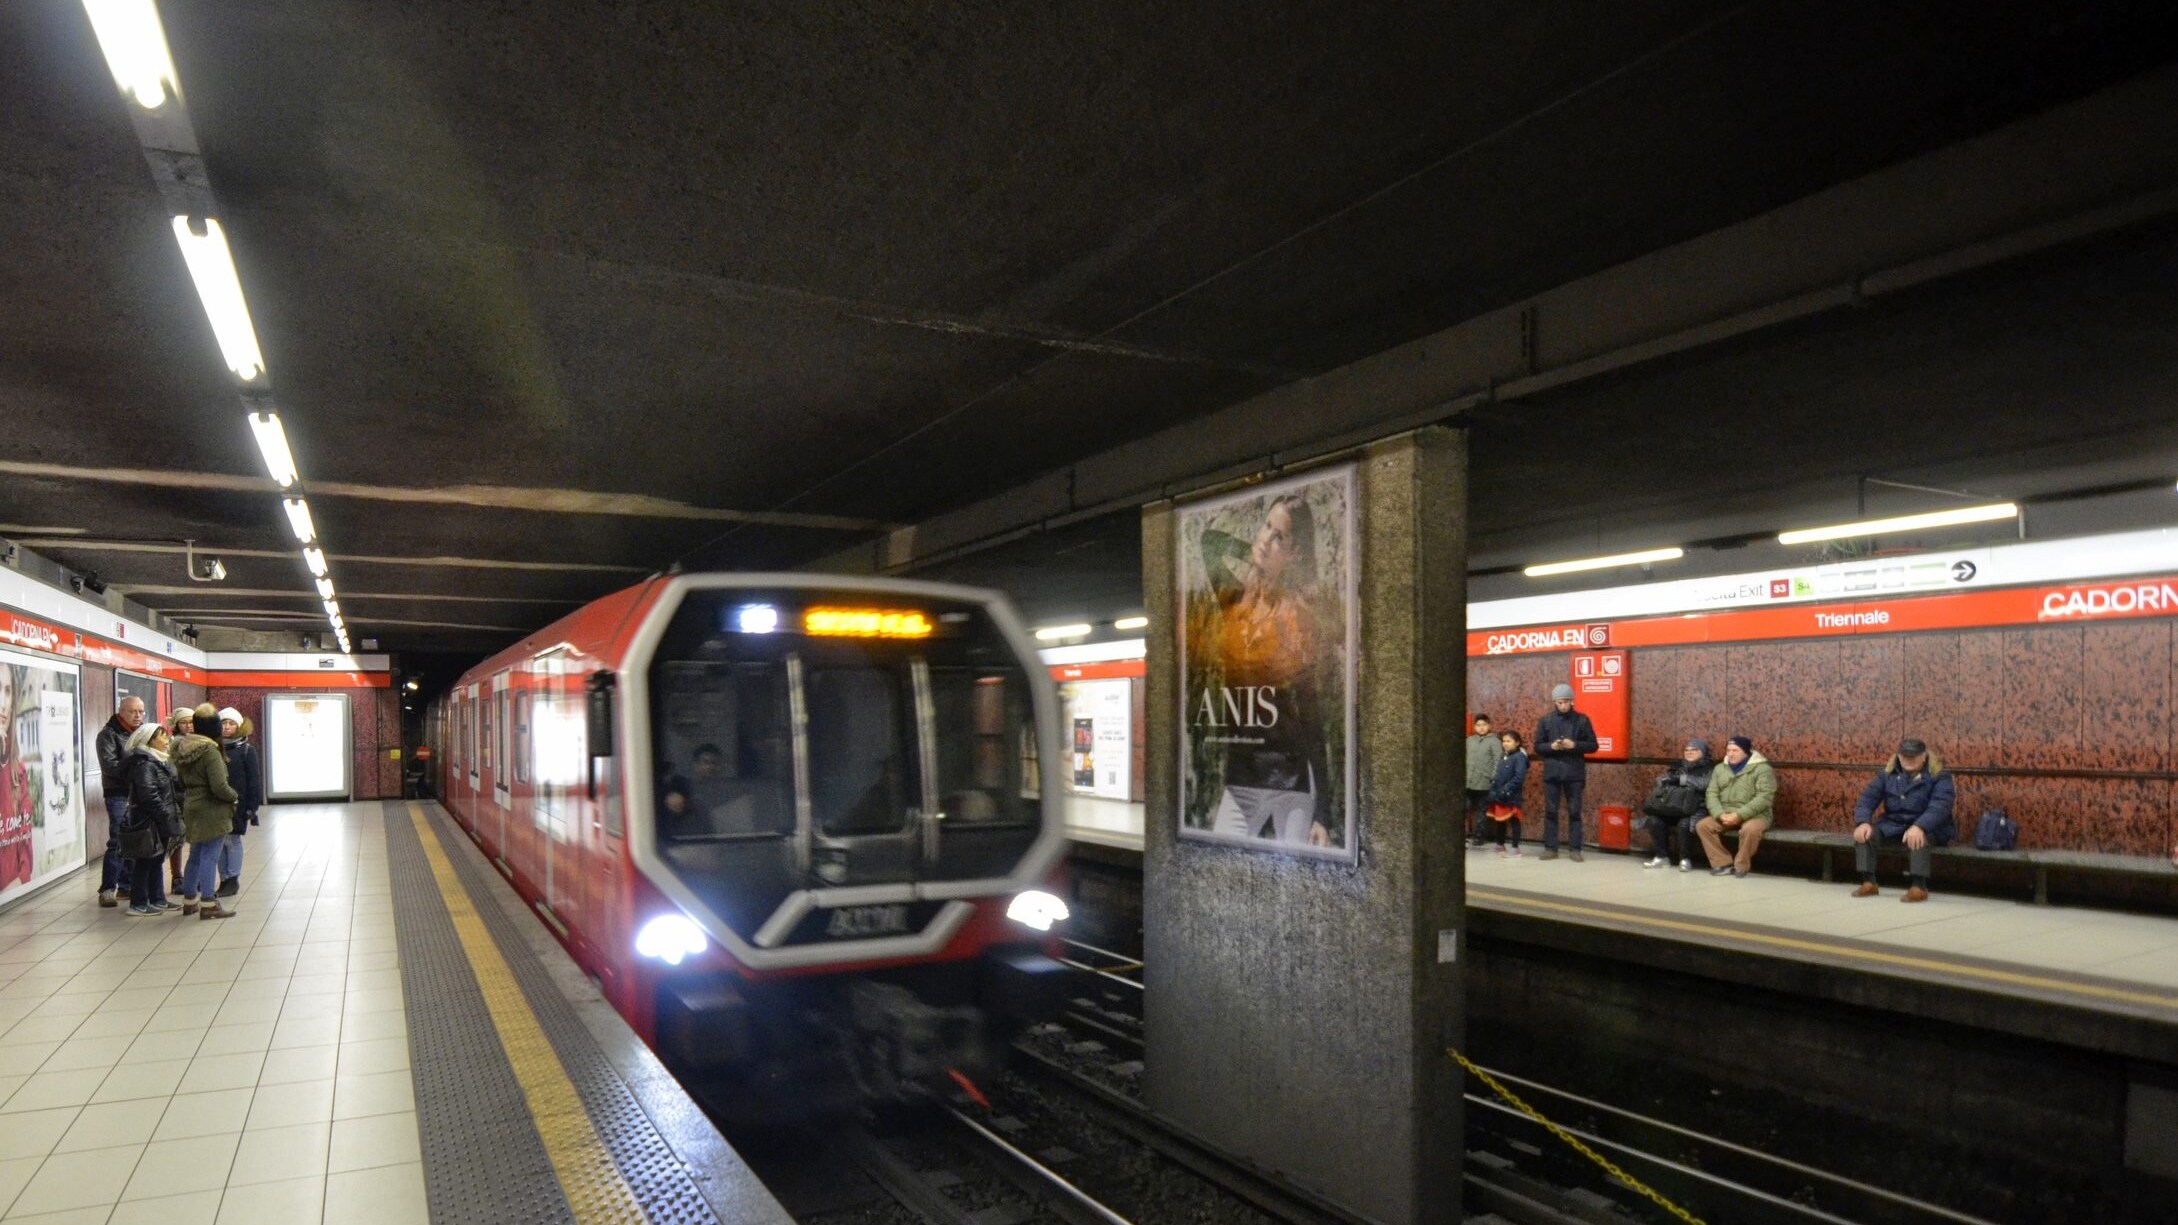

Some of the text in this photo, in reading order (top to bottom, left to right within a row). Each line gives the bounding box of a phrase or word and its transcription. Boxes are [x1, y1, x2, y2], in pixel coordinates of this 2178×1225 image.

[1739, 584, 1763, 598] Exit
[1773, 584, 1786, 594] S3
[2043, 583, 2178, 616] CADORN
[1815, 610, 1889, 628] Triennale
[1487, 631, 1560, 651] CADORNA
[1194, 685, 1279, 728] ANIS
